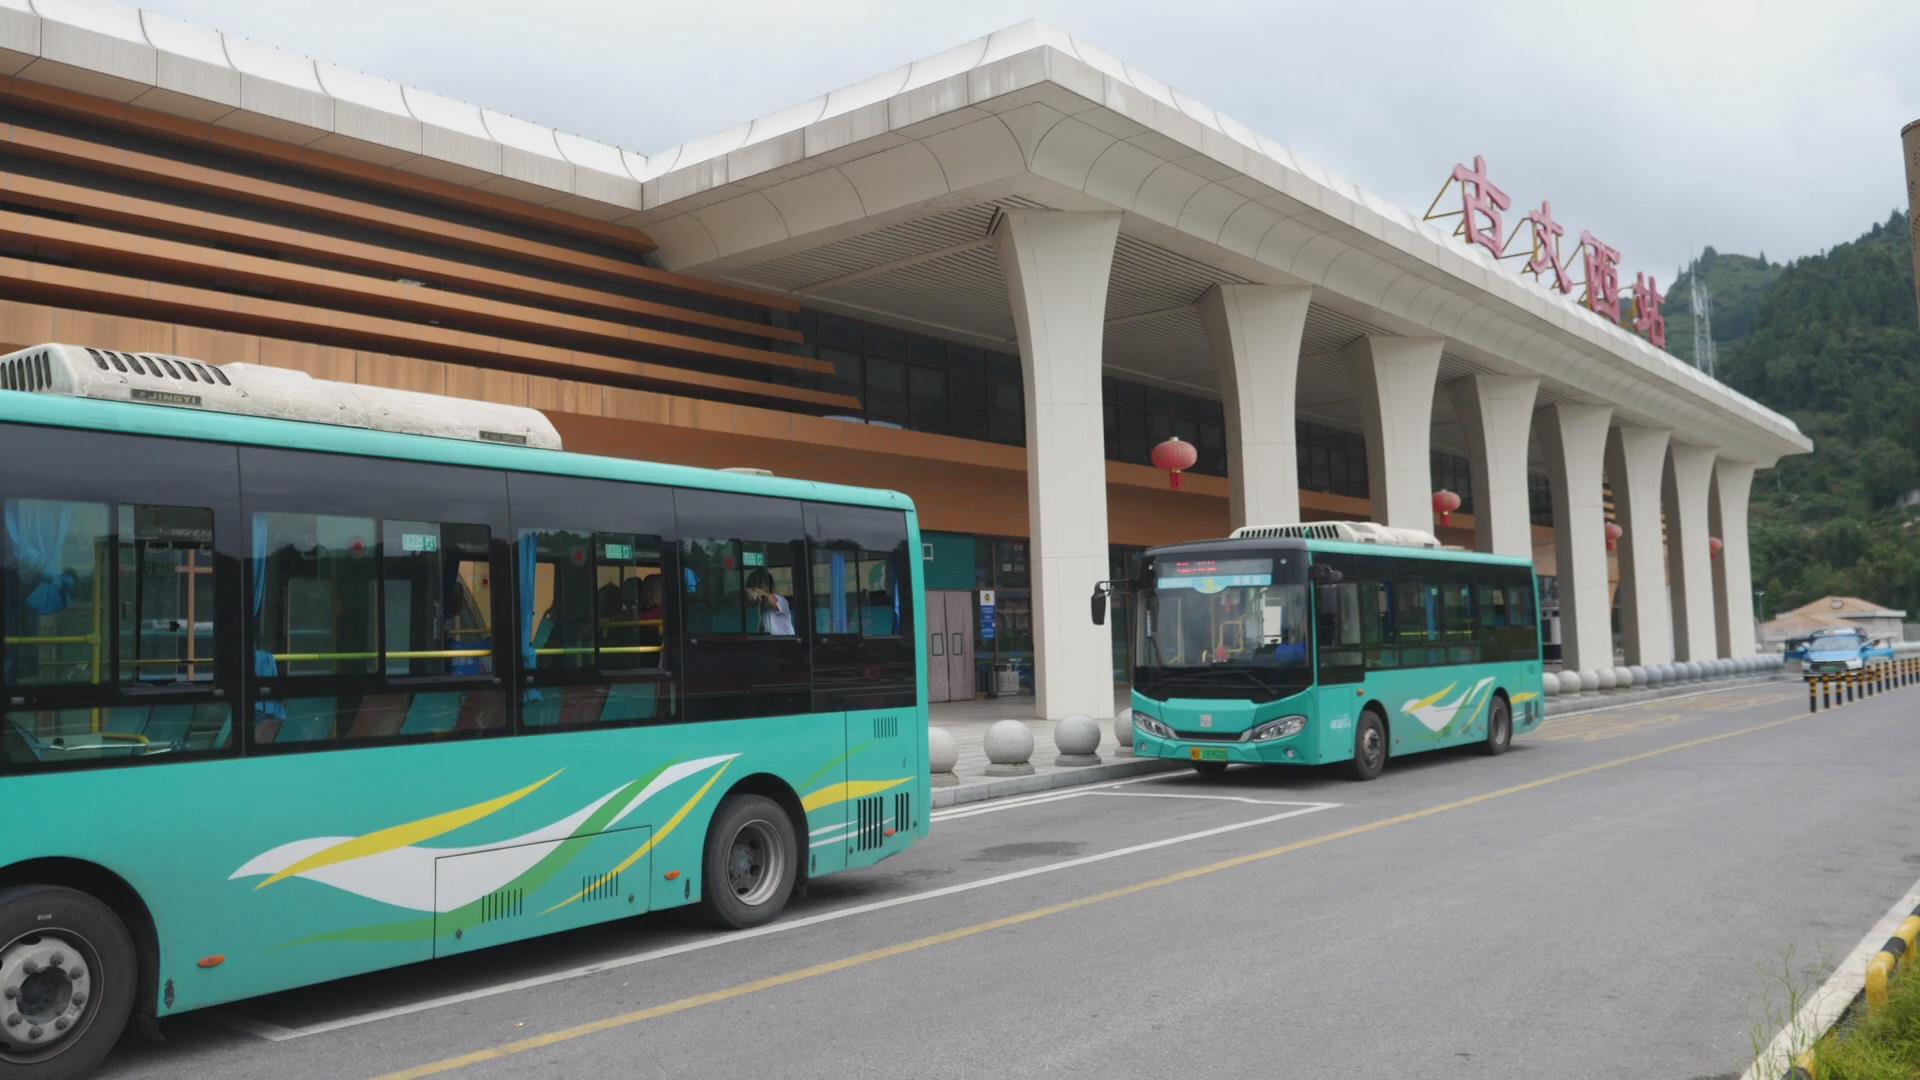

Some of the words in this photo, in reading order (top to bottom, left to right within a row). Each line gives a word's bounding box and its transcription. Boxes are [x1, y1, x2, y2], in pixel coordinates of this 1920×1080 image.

[1452, 154, 1666, 350] 古丈西站
[148, 392, 196, 405] JINGYI
